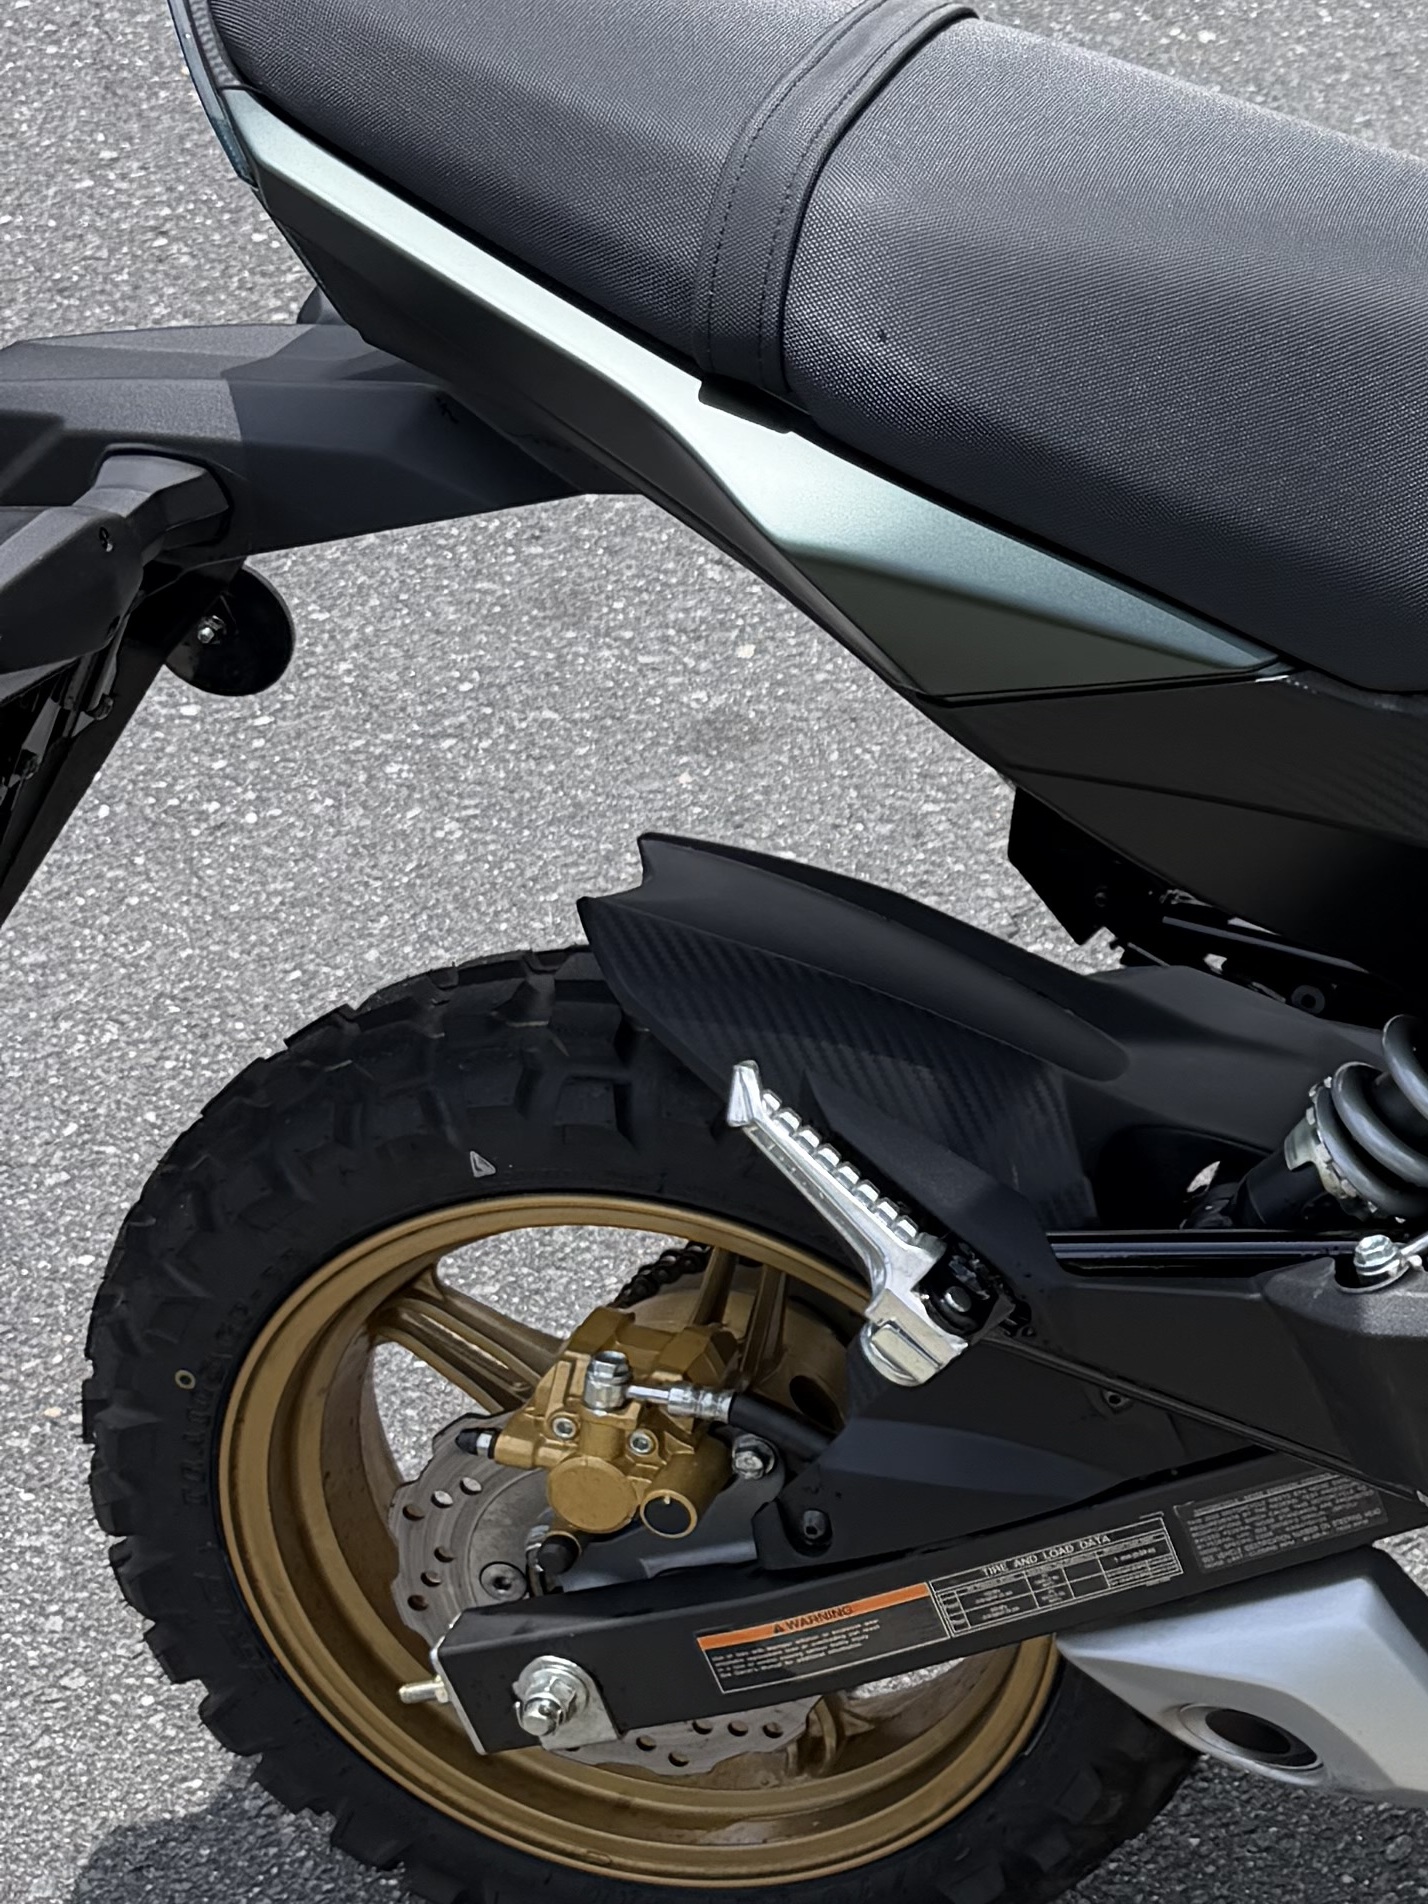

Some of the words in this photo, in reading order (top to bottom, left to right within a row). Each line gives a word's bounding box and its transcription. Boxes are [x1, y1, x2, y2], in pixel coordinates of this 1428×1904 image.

[981, 1563, 1007, 1577] TIRE
[1013, 1554, 1038, 1568] AND
[1043, 1544, 1075, 1560] LOAD
[1079, 1534, 1111, 1550] DATA
[785, 1606, 854, 1630] WARNING
